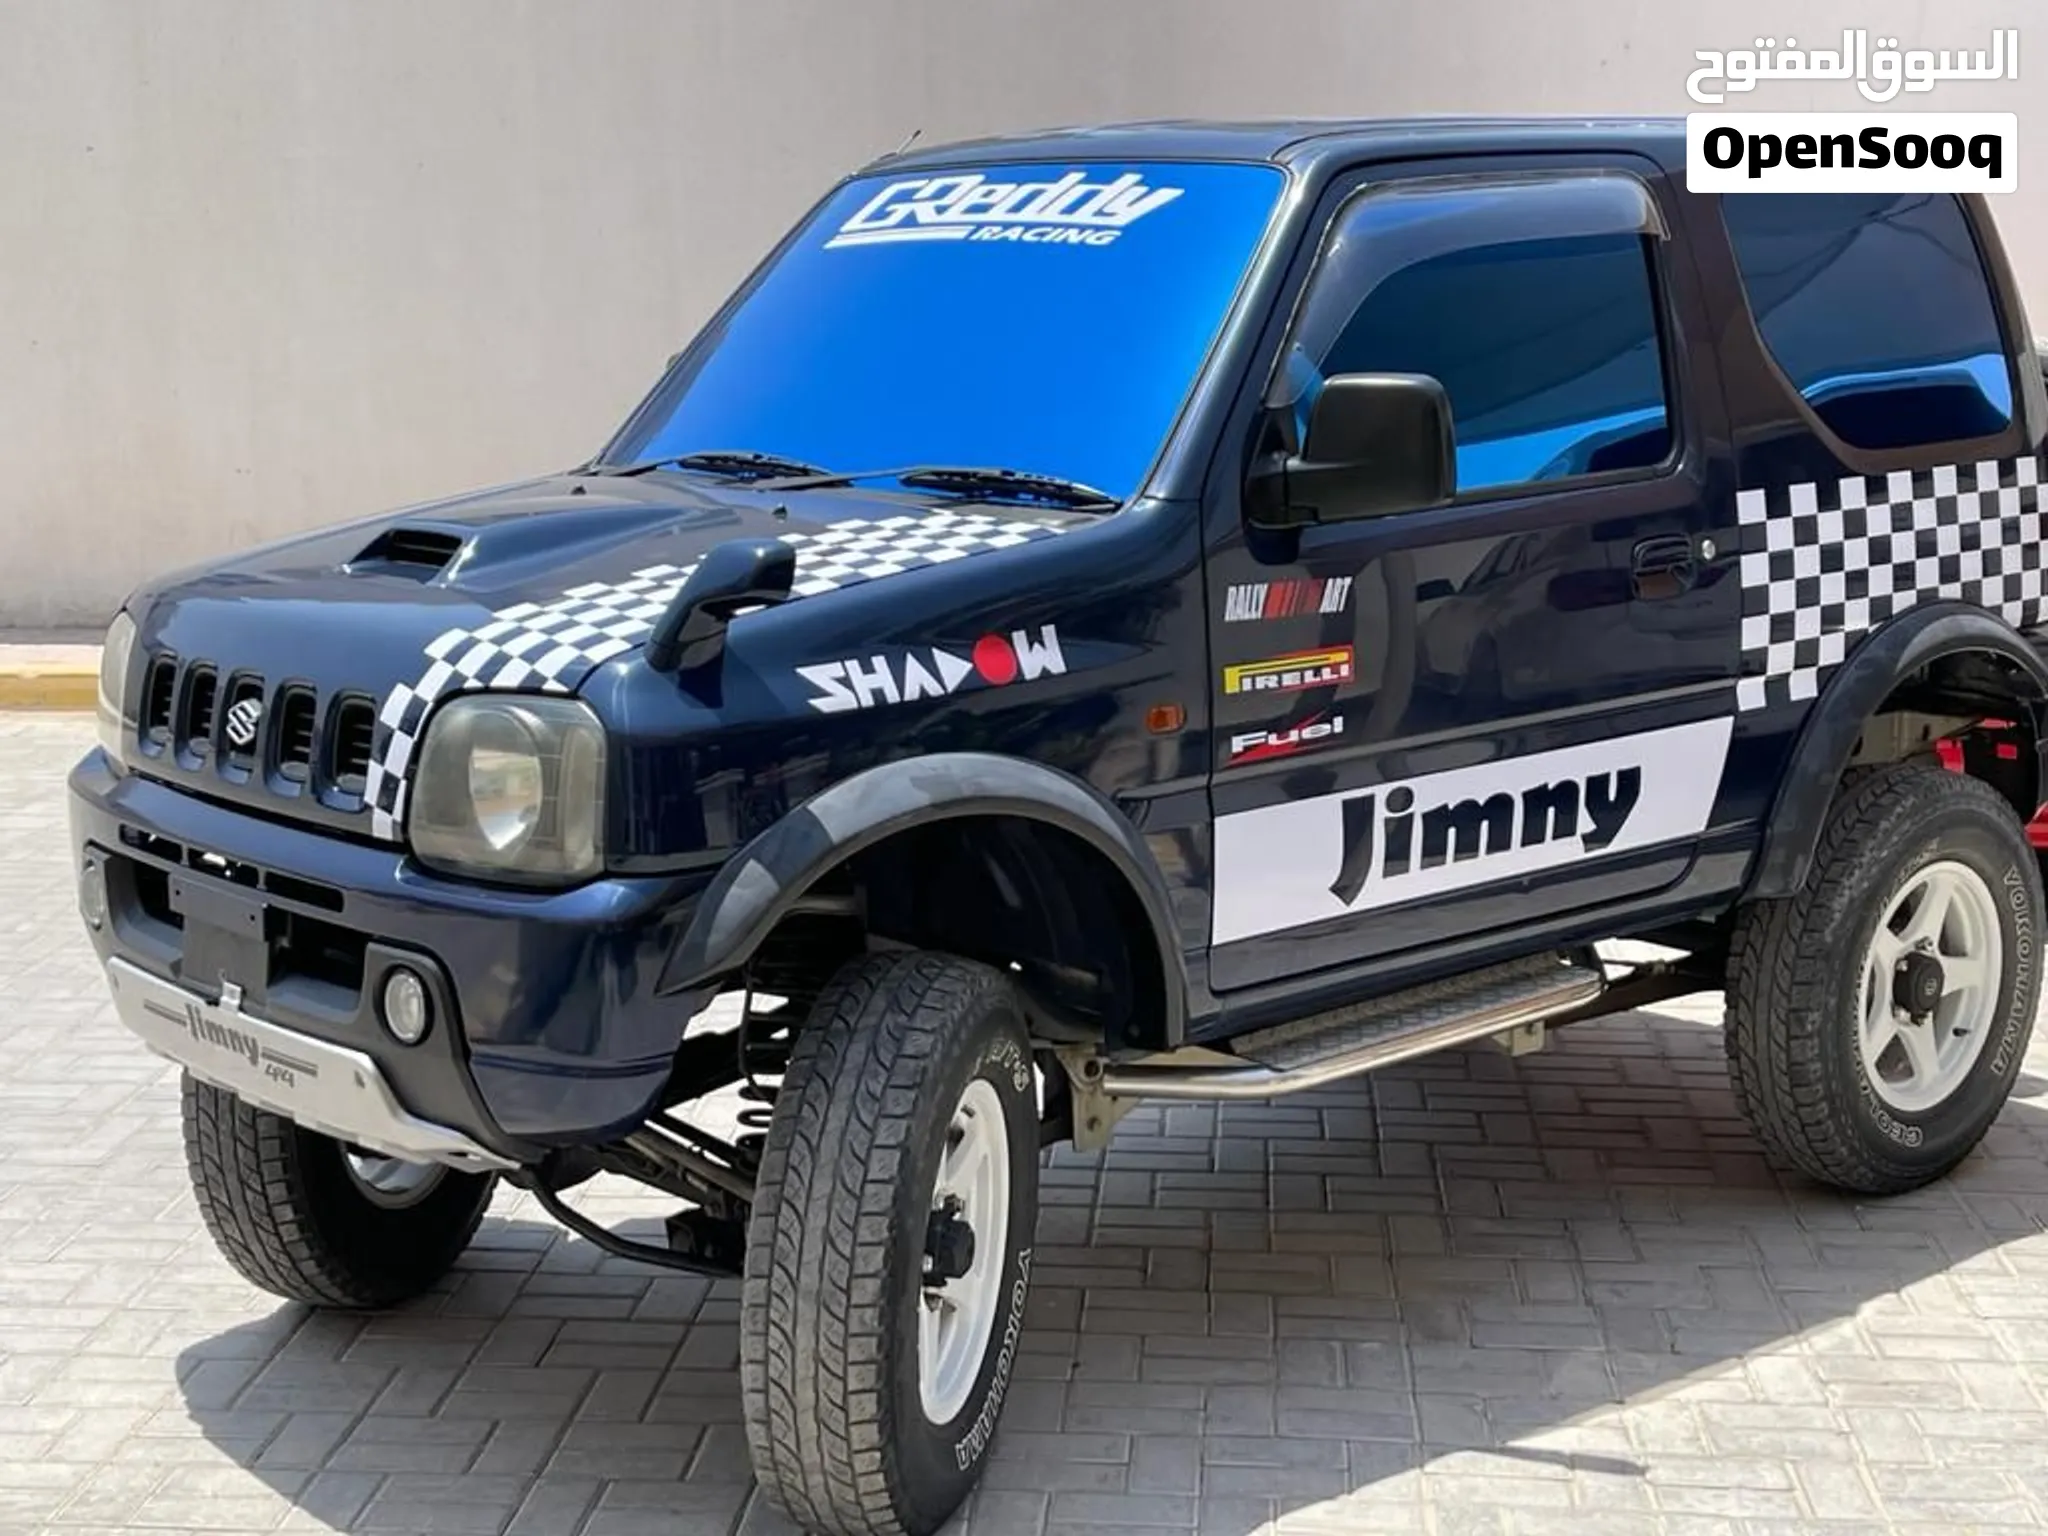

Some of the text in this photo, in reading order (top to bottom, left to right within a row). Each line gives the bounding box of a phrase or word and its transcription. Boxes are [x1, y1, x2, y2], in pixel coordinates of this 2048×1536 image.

[970, 225, 1122, 246] RACING
[795, 624, 1067, 713] SHADOW
[1223, 651, 1350, 694] PIRELLI
[1231, 716, 1344, 753] Fuel
[1329, 766, 1642, 907] Jimny
[1990, 864, 2033, 1076] YOKOHAMA
[185, 1002, 260, 1067] Jimny
[955, 1248, 1032, 1470] YOKOHAMA
